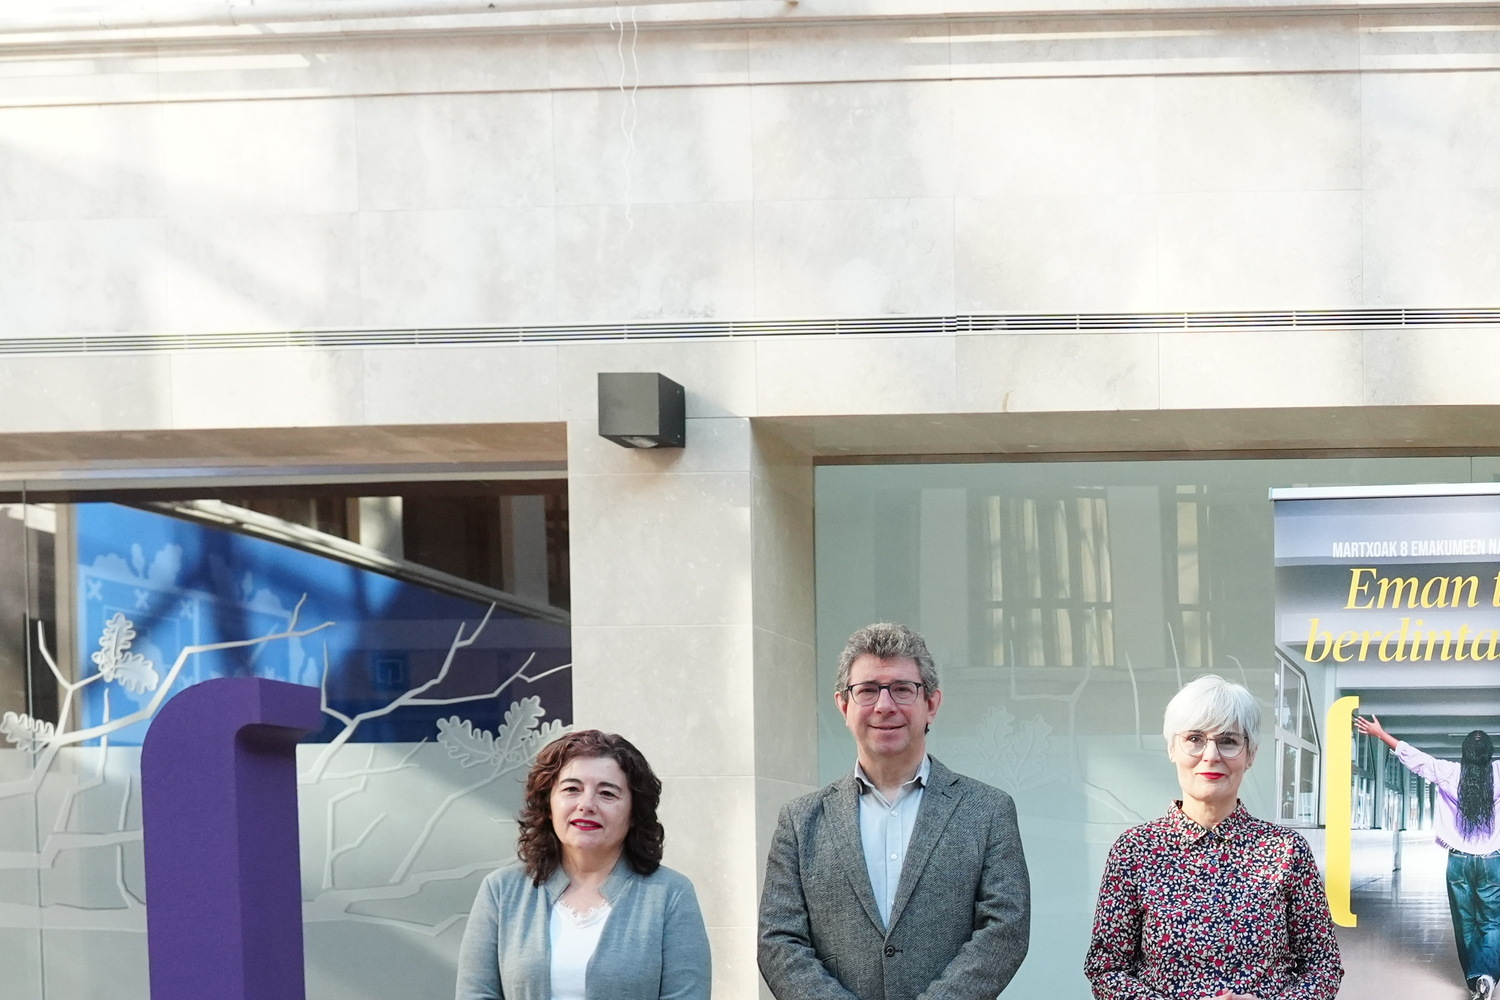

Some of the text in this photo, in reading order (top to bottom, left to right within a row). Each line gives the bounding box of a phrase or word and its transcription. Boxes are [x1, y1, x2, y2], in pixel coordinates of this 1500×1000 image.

[1332, 541, 1398, 558] MARTXOAK
[1400, 541, 1408, 557] 8
[1411, 538, 1486, 556] EMAKUMEEN
[1343, 567, 1479, 610] Eman
